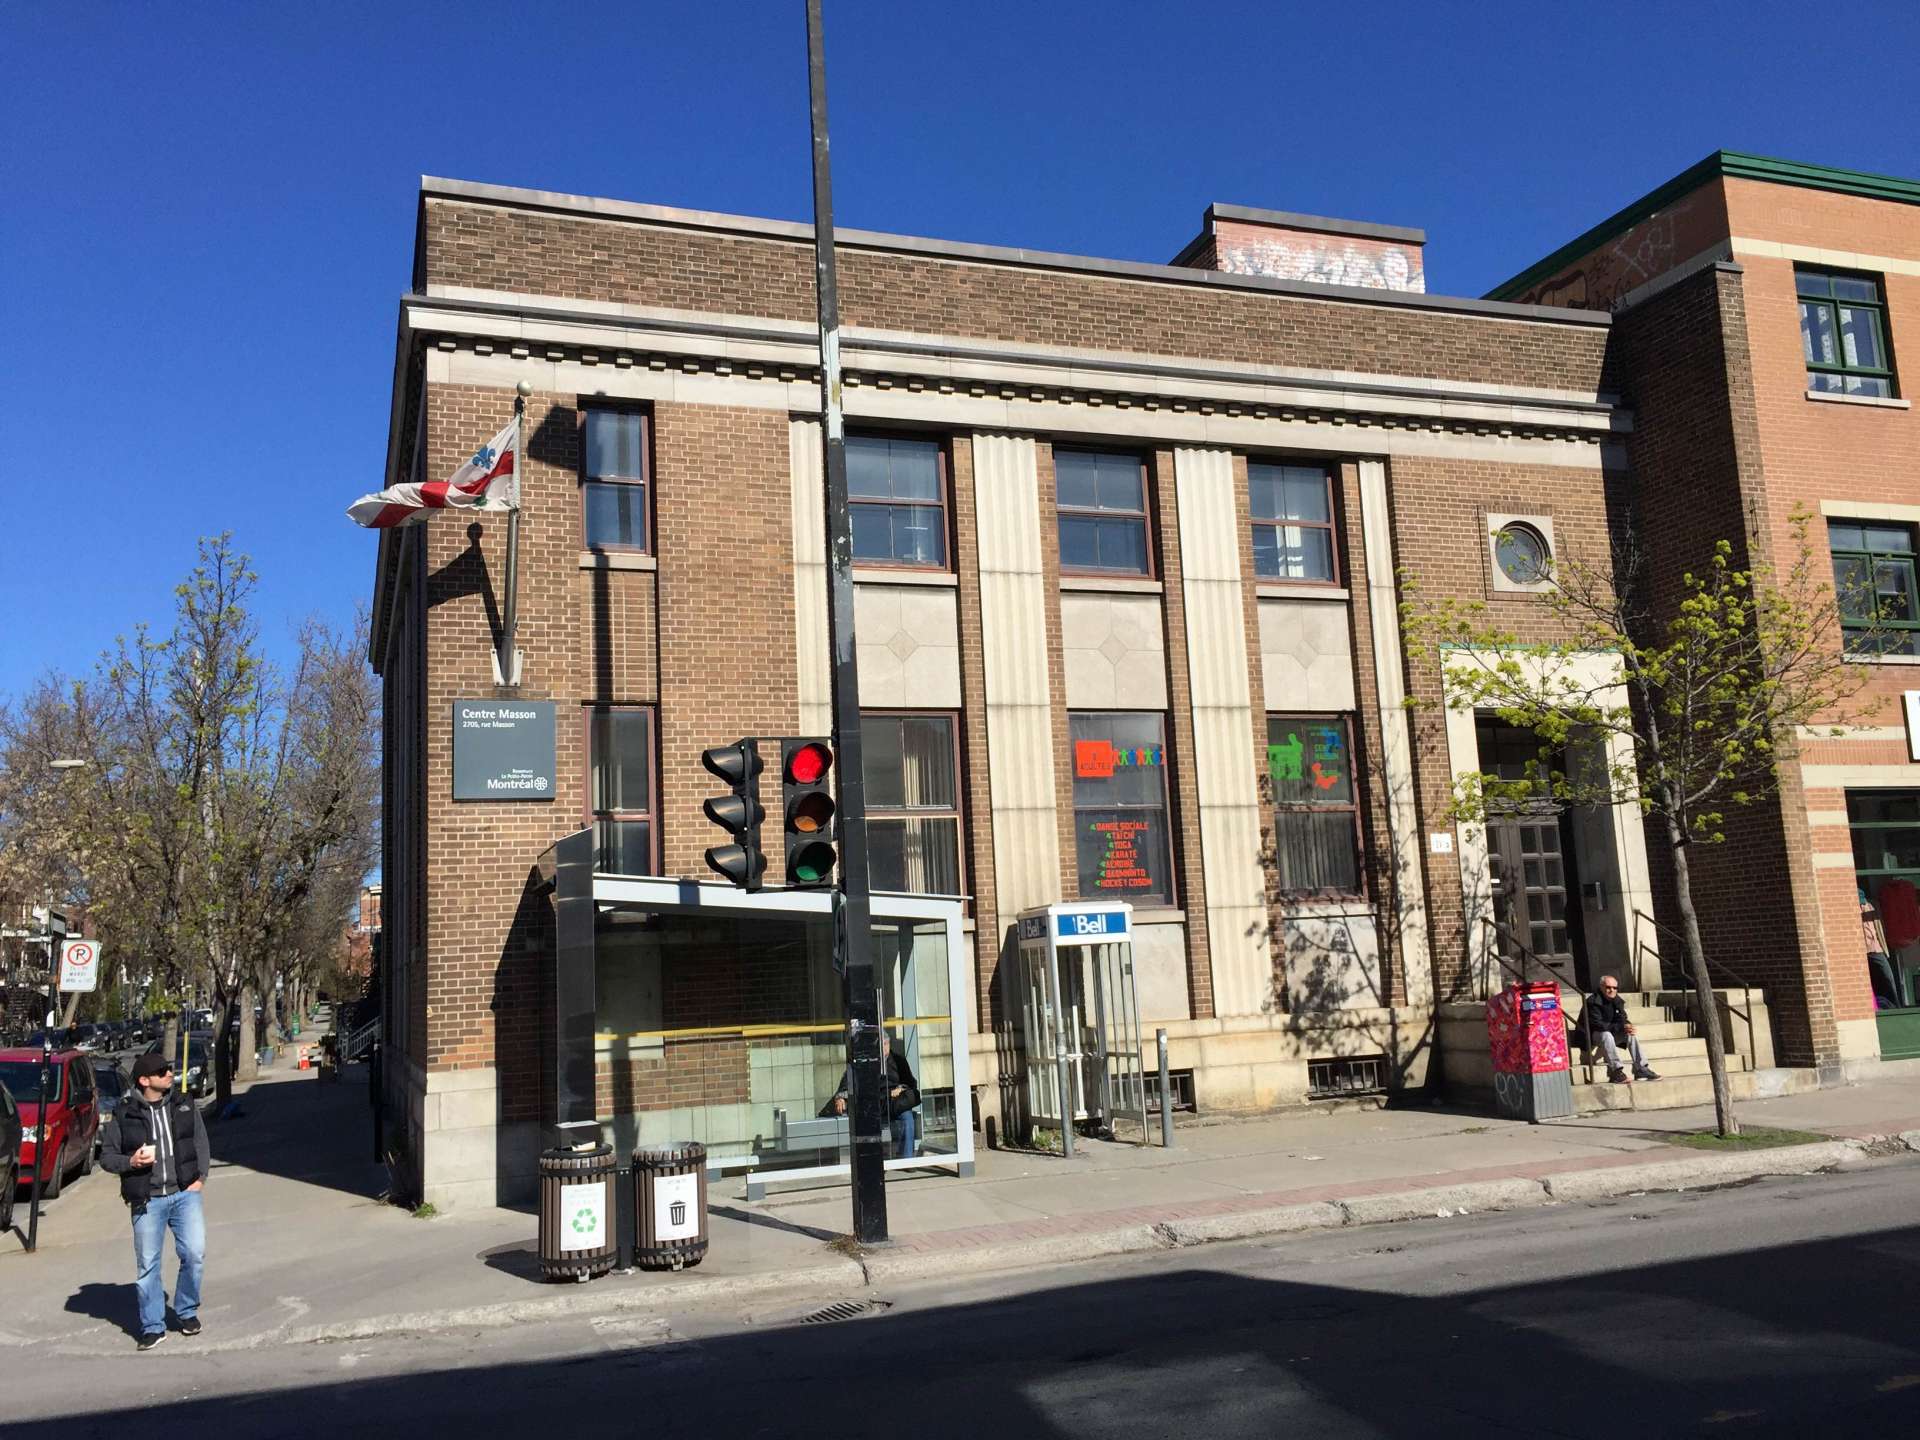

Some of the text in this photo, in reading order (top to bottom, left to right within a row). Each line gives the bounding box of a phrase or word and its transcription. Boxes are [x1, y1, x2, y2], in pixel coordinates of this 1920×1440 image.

[462, 708, 536, 719] Centre Masson
[487, 779, 533, 789] Montréal
[1114, 840, 1133, 849] YOGA
[1100, 878, 1128, 888] HOCKEY
[1026, 919, 1040, 938] Bell
[1076, 913, 1107, 934] Bell
